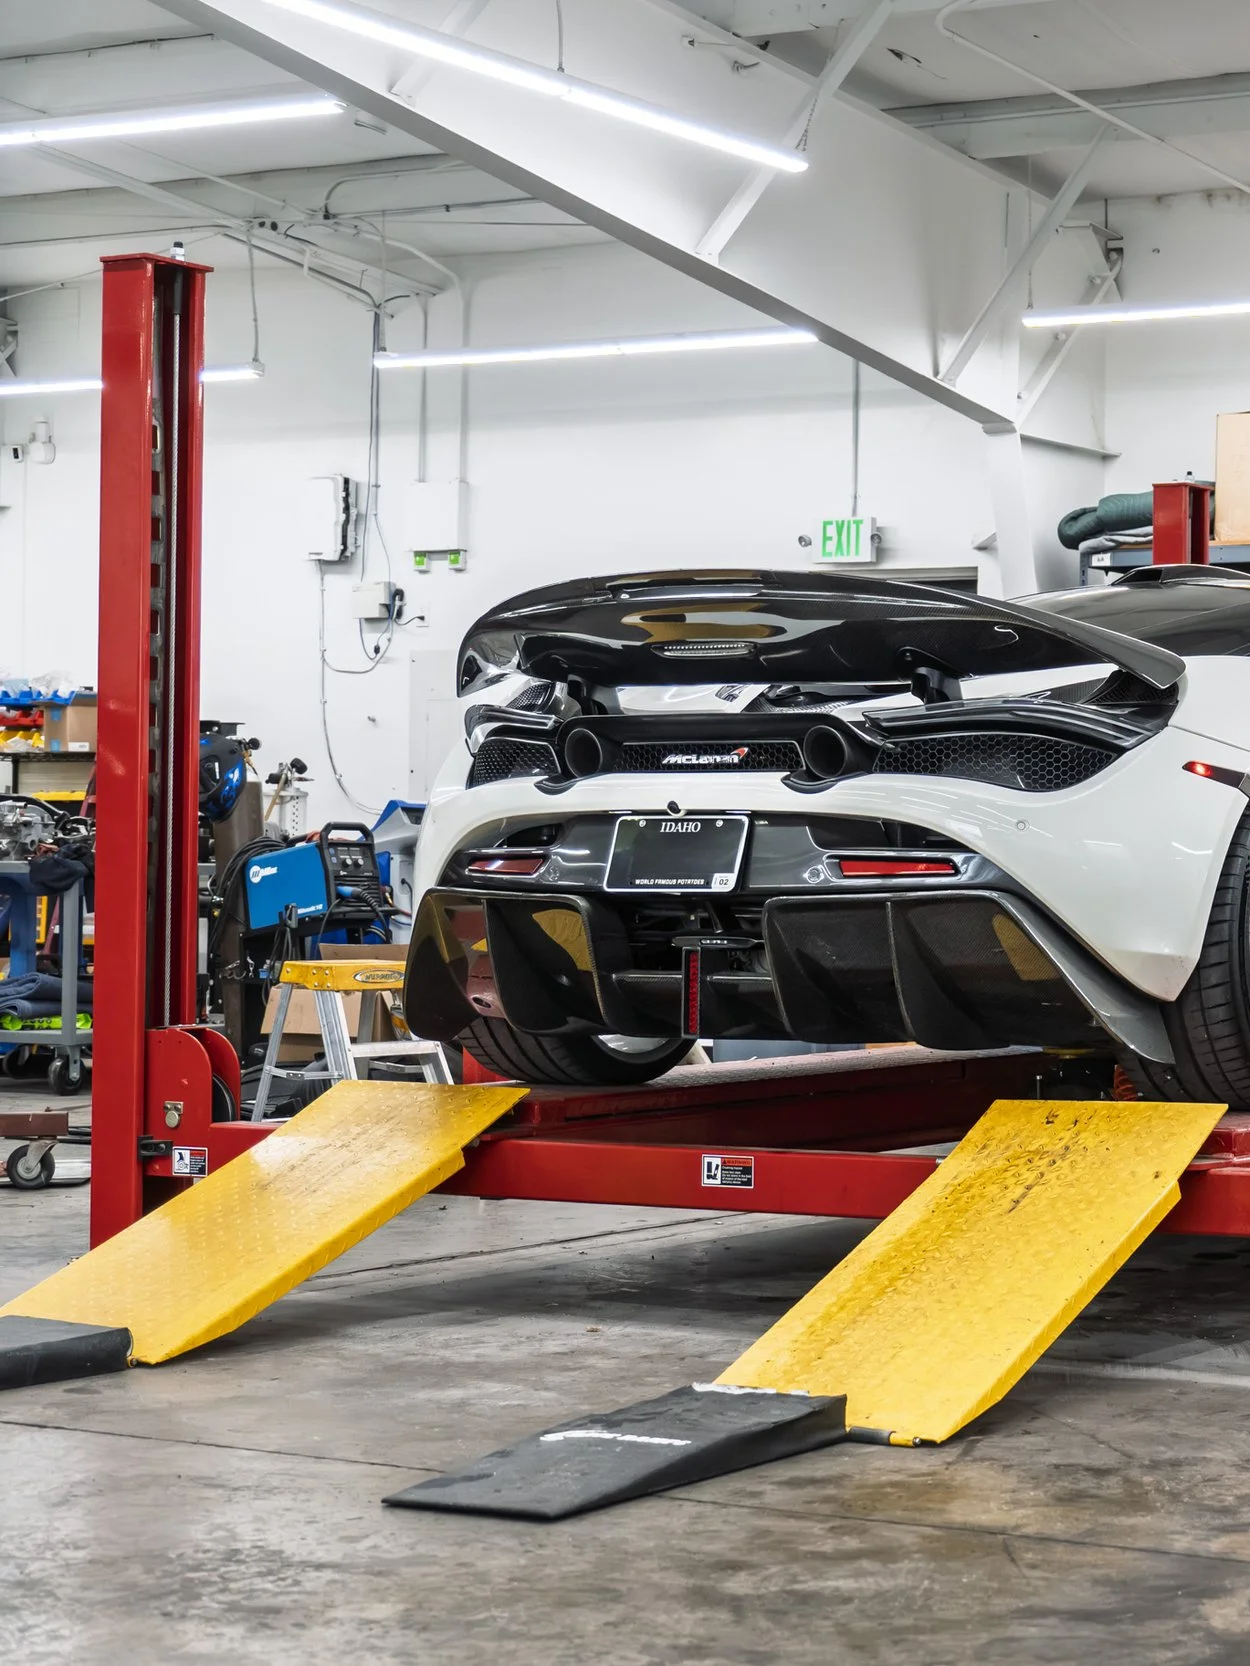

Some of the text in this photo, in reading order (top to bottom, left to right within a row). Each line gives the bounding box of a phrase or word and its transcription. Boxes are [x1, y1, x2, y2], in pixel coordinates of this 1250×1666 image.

[821, 519, 864, 558] EXIT
[662, 752, 741, 764] McLaren
[660, 821, 701, 833] IDAHO
[718, 878, 729, 886] 02
